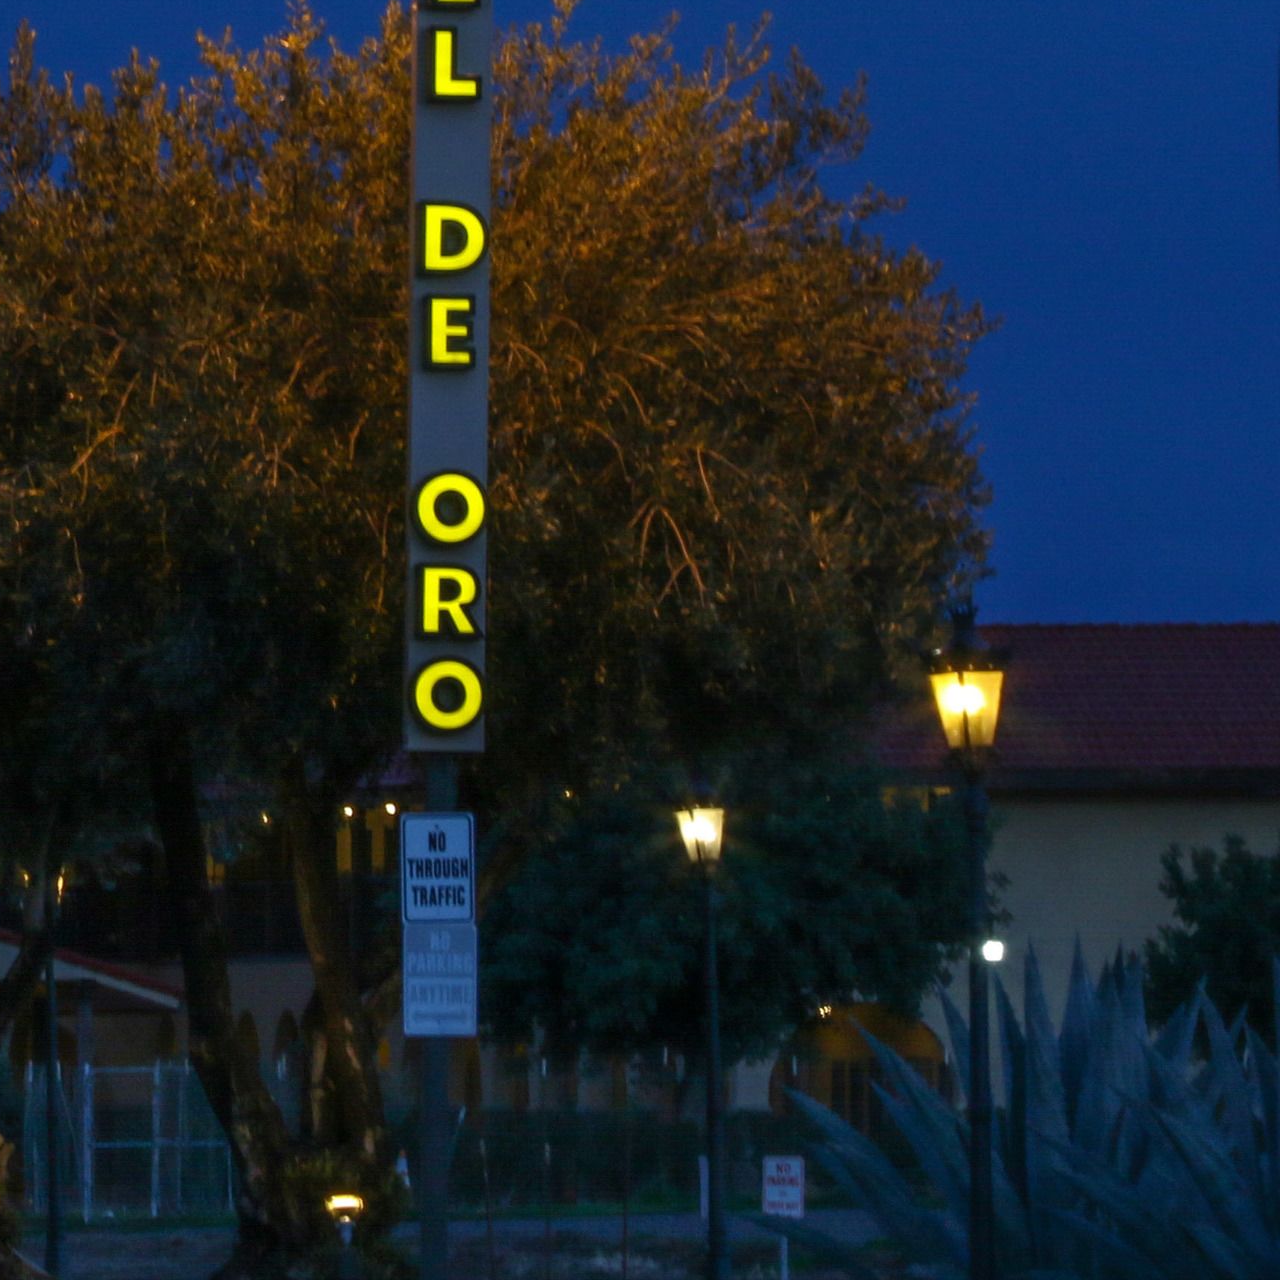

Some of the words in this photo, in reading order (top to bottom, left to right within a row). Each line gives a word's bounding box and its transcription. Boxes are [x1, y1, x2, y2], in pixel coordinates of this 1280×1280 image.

[424, 204, 485, 365] DE
[414, 473, 486, 730] ORO
[428, 831, 446, 852] NO
[408, 858, 469, 879] THROUGH
[412, 885, 465, 907] TRAFFIC
[430, 930, 450, 951] NO
[407, 952, 472, 974] PARKING
[410, 983, 471, 1005] ANYTIME
[776, 1163, 791, 1174] NO
